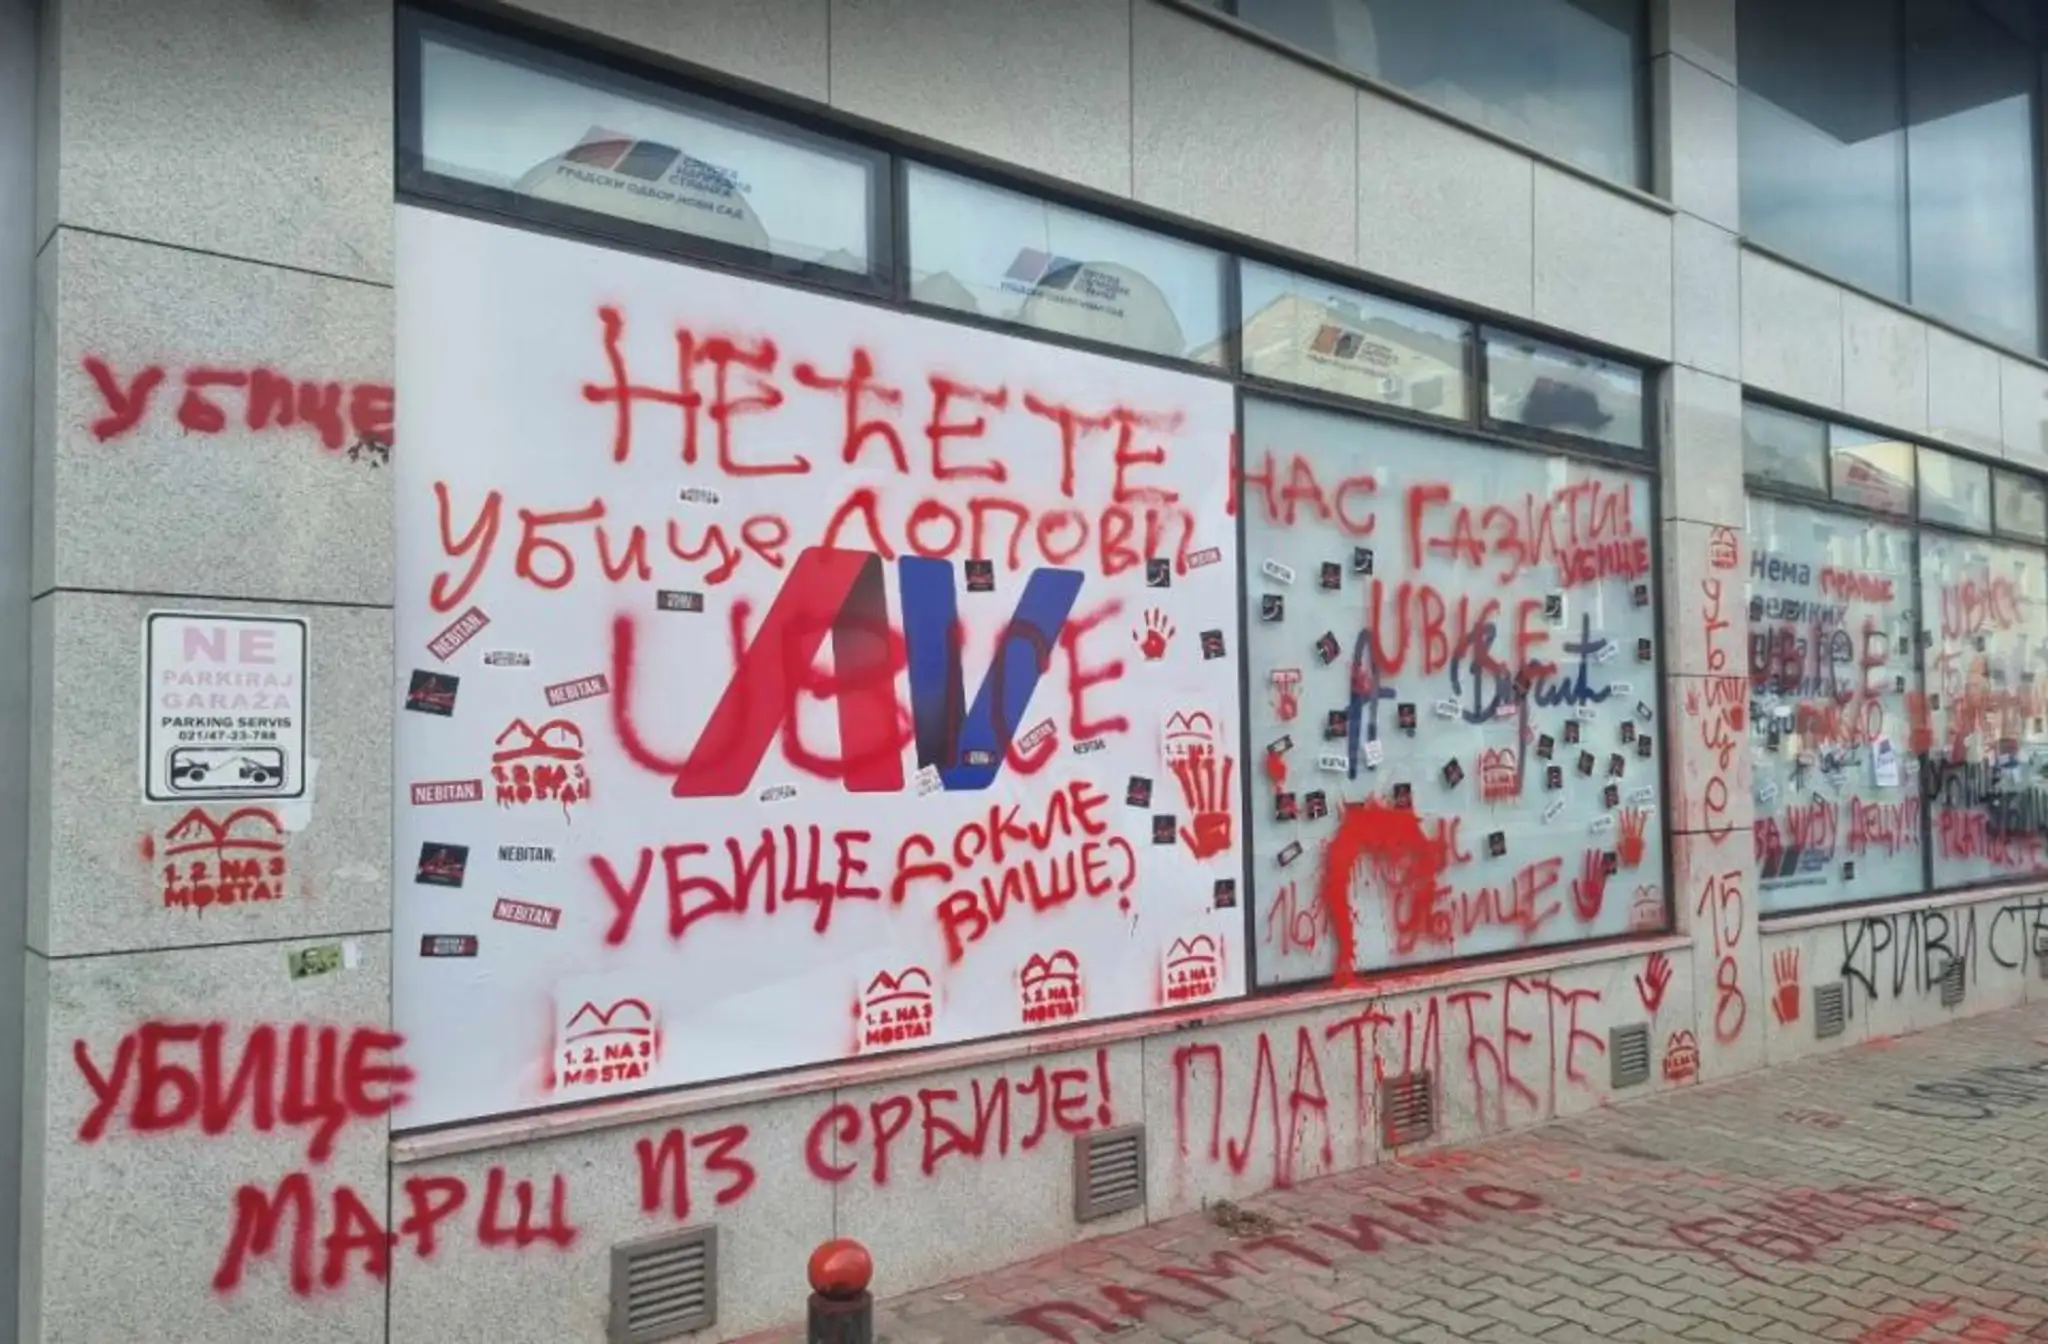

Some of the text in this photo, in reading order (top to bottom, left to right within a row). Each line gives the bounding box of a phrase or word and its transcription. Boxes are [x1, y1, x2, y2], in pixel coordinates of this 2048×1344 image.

[1750, 550, 1810, 585] Нема
[183, 627, 276, 664] NE
[163, 670, 293, 687] PARKIRAJ
[161, 689, 291, 709] GARAŽA
[162, 716, 291, 728] PARKING SERVIS
[592, 824, 882, 945] УБИЦЕ
[605, 1042, 634, 1060] NA
[73, 1020, 413, 1163] УБИЦЕ
[212, 1048, 1111, 1297] МАРШ ИЗ СРБИЈЕ!
